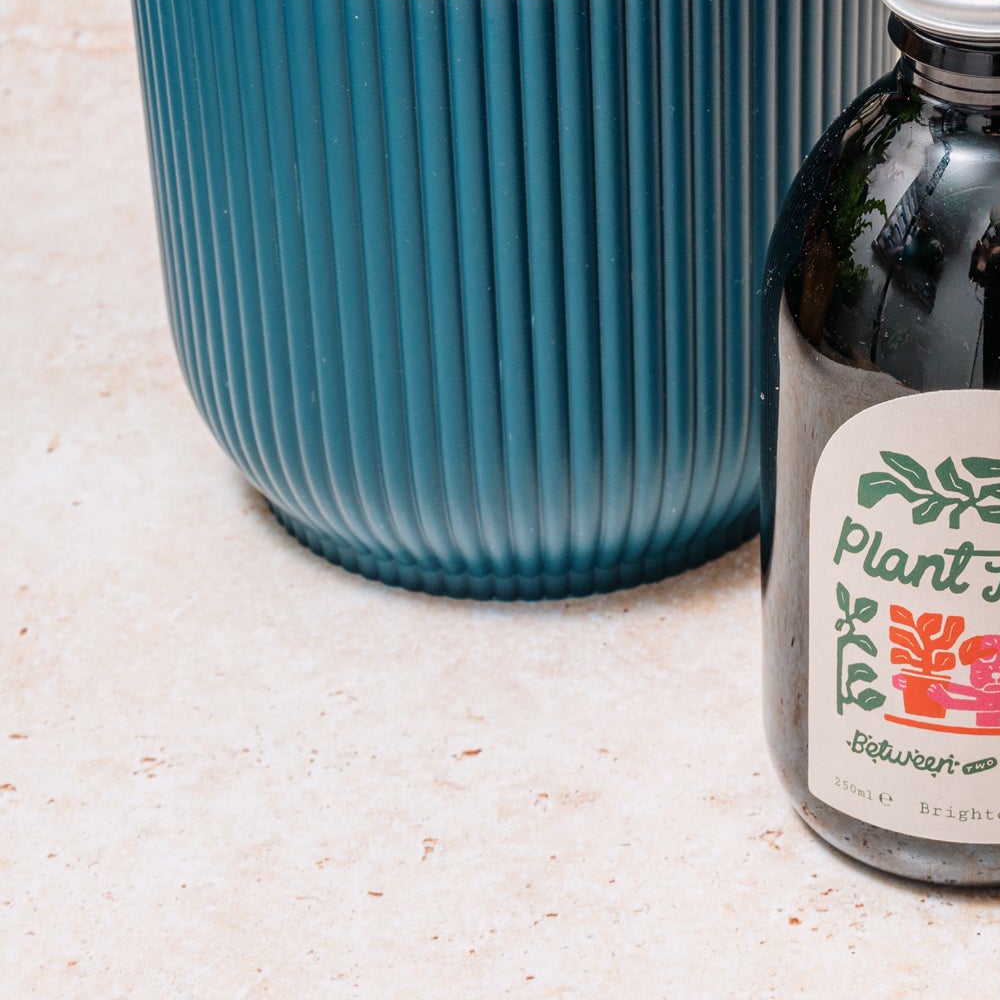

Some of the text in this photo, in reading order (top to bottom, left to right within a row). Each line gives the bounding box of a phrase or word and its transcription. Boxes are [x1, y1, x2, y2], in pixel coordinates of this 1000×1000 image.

[850, 729, 956, 775] Between
[966, 759, 994, 773] TWO
[834, 776, 873, 801] 250ml
